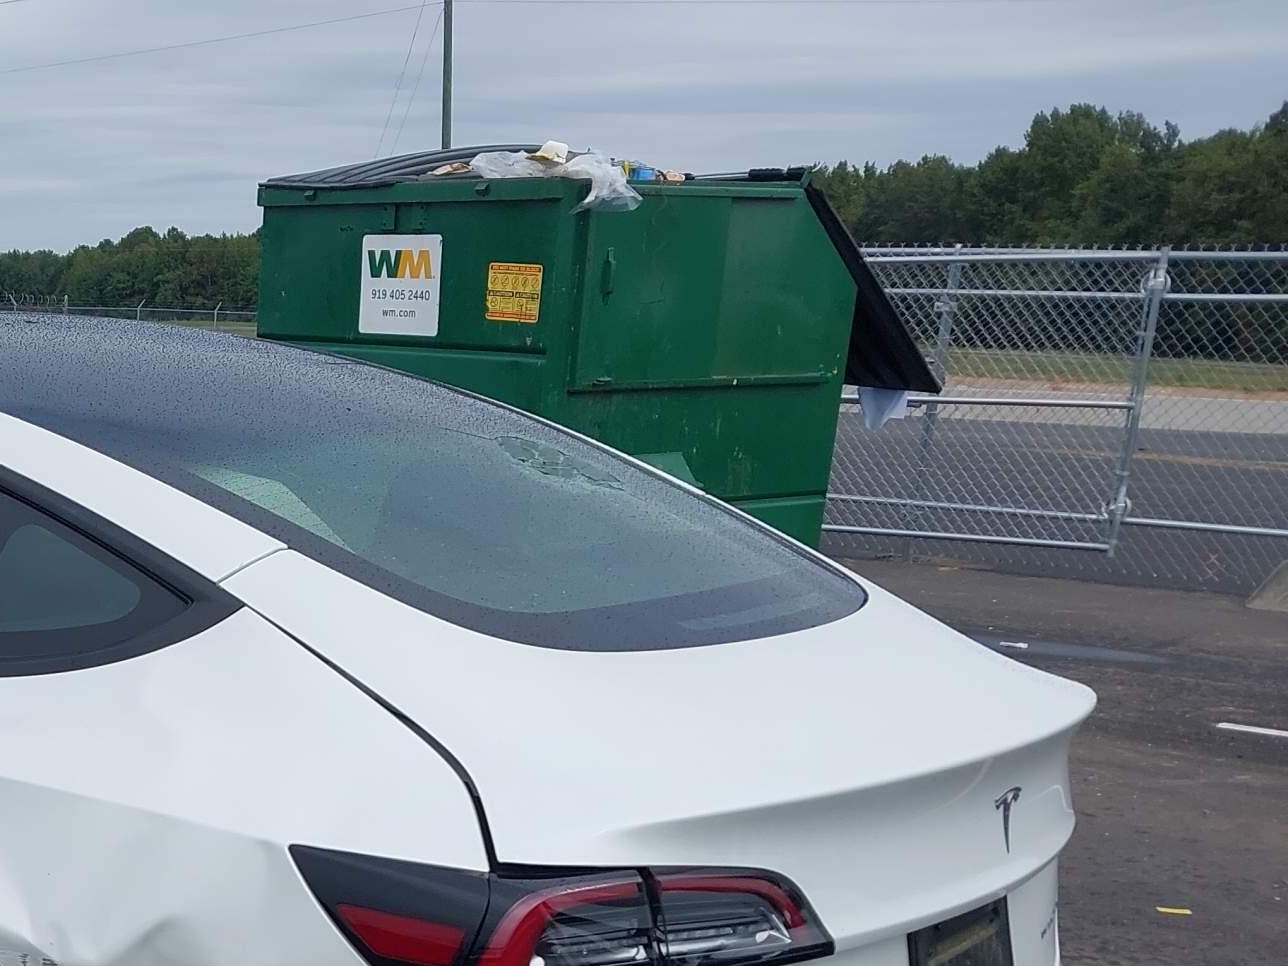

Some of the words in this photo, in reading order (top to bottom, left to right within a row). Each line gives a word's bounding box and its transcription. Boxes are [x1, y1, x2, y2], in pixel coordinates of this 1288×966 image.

[367, 249, 433, 279] WM
[371, 288, 387, 300] 919
[389, 289, 406, 301] 405
[407, 289, 431, 301] 2440
[382, 309, 416, 318] wm.com
